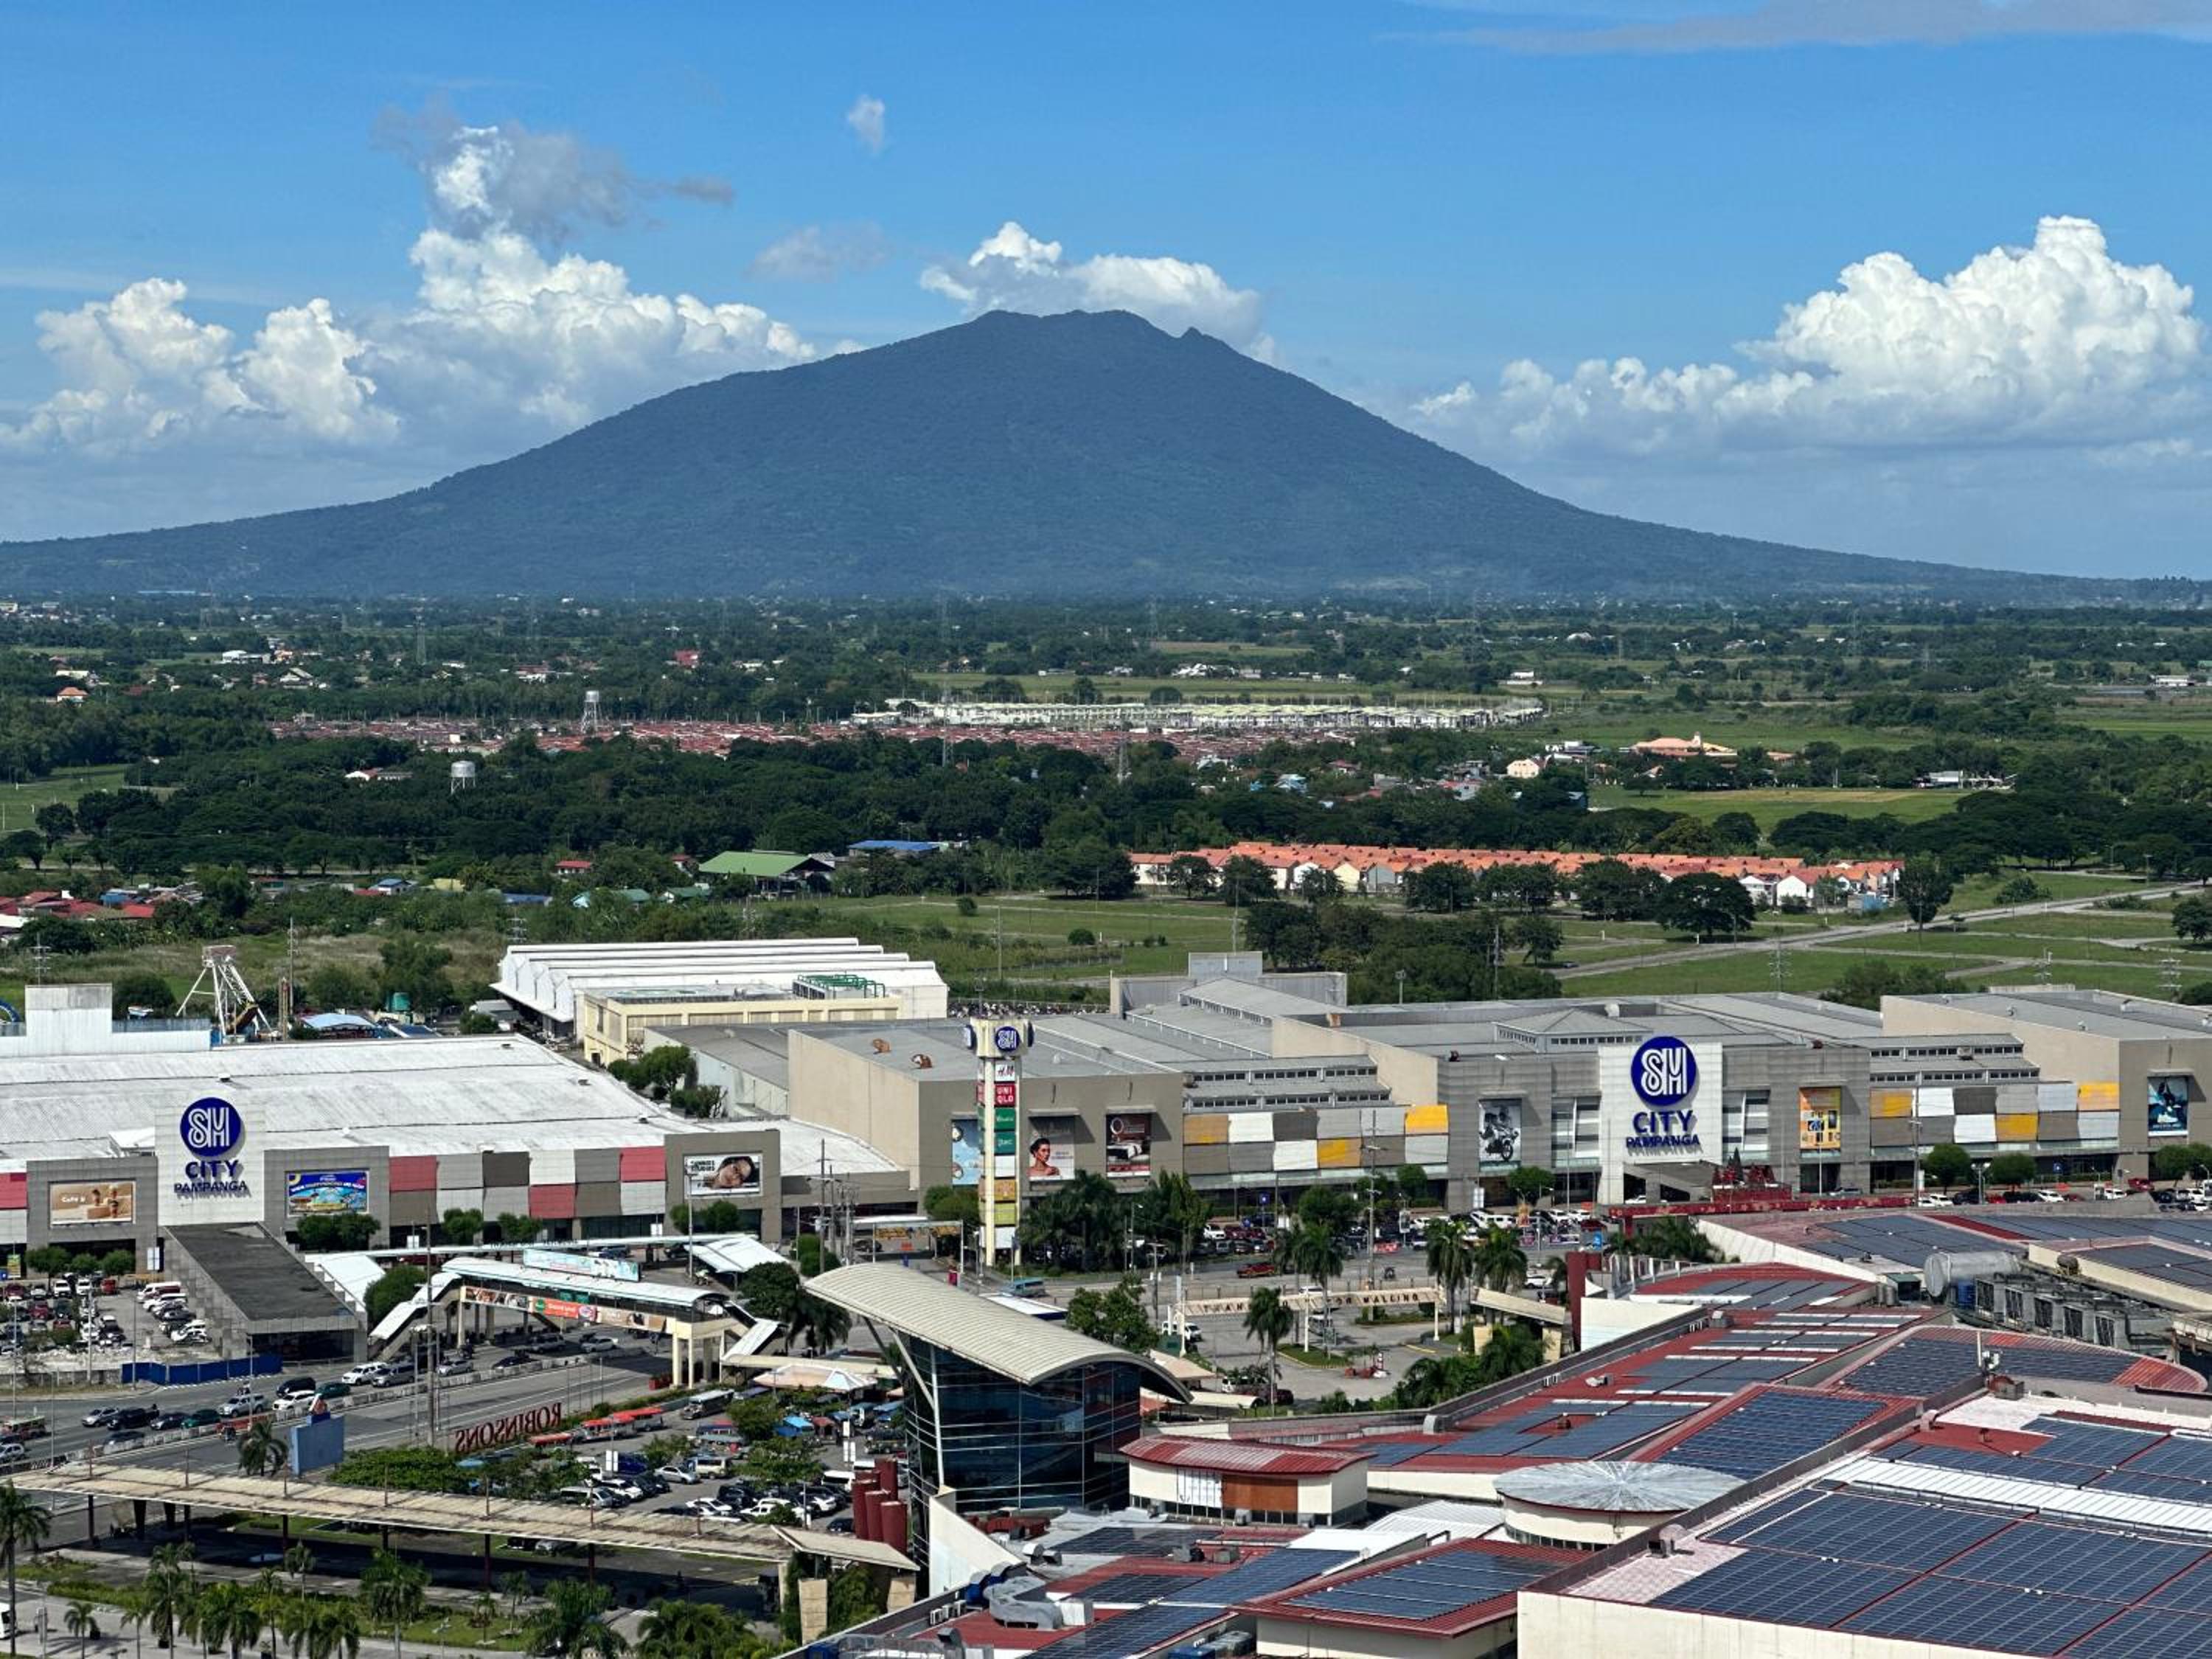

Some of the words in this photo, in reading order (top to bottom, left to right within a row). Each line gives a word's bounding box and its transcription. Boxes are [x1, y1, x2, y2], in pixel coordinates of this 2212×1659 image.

[1641, 1047, 1687, 1096] SM
[188, 1107, 229, 1148] SM
[1632, 1110, 1693, 1133] CITY
[1626, 1135, 1700, 1148] PAMPANGA
[185, 1159, 239, 1179] CITY
[174, 1180, 248, 1193] PAMPANGA
